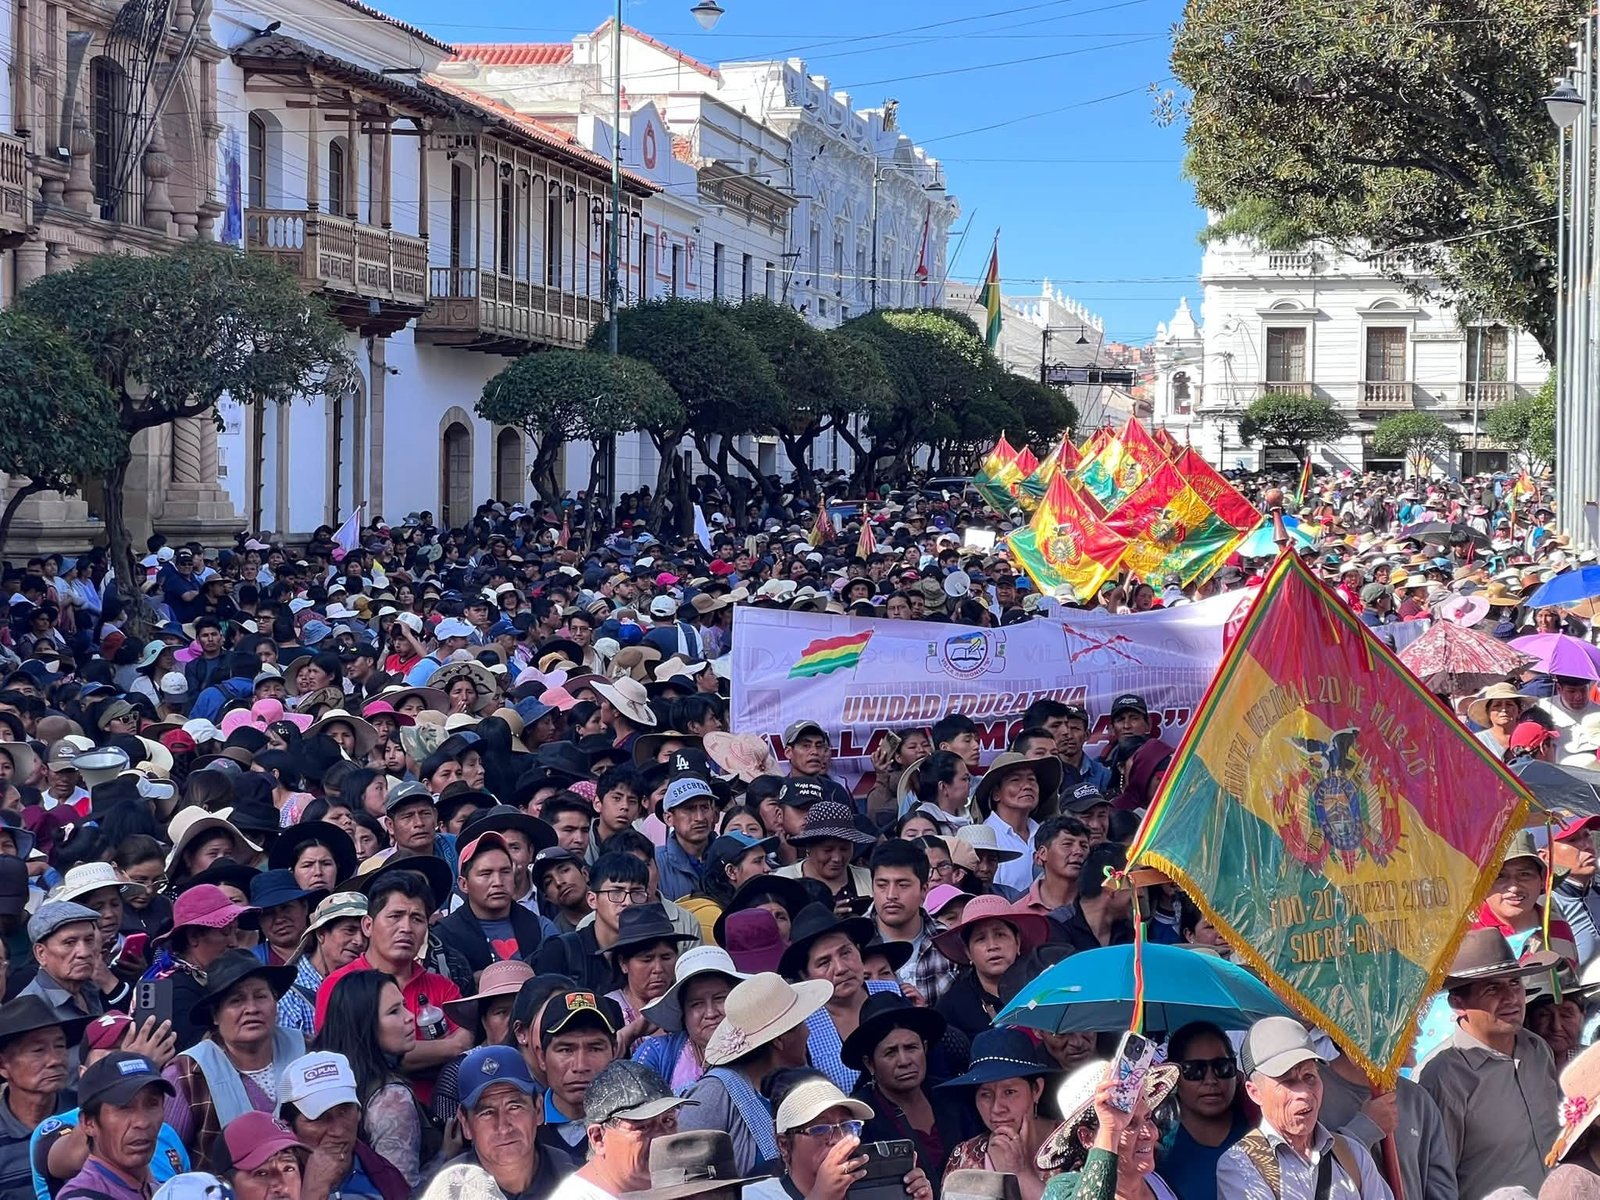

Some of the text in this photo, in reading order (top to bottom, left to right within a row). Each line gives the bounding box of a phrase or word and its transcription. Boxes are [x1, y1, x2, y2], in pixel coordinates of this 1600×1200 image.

[842, 694, 942, 725] UNIDAD
[1243, 676, 1315, 738] VECINAL
[1317, 675, 1342, 704] 20
[1349, 680, 1366, 714] DE
[1369, 700, 1428, 777] MARZO
[676, 754, 690, 771] LA
[317, 1066, 337, 1075] PLAN
